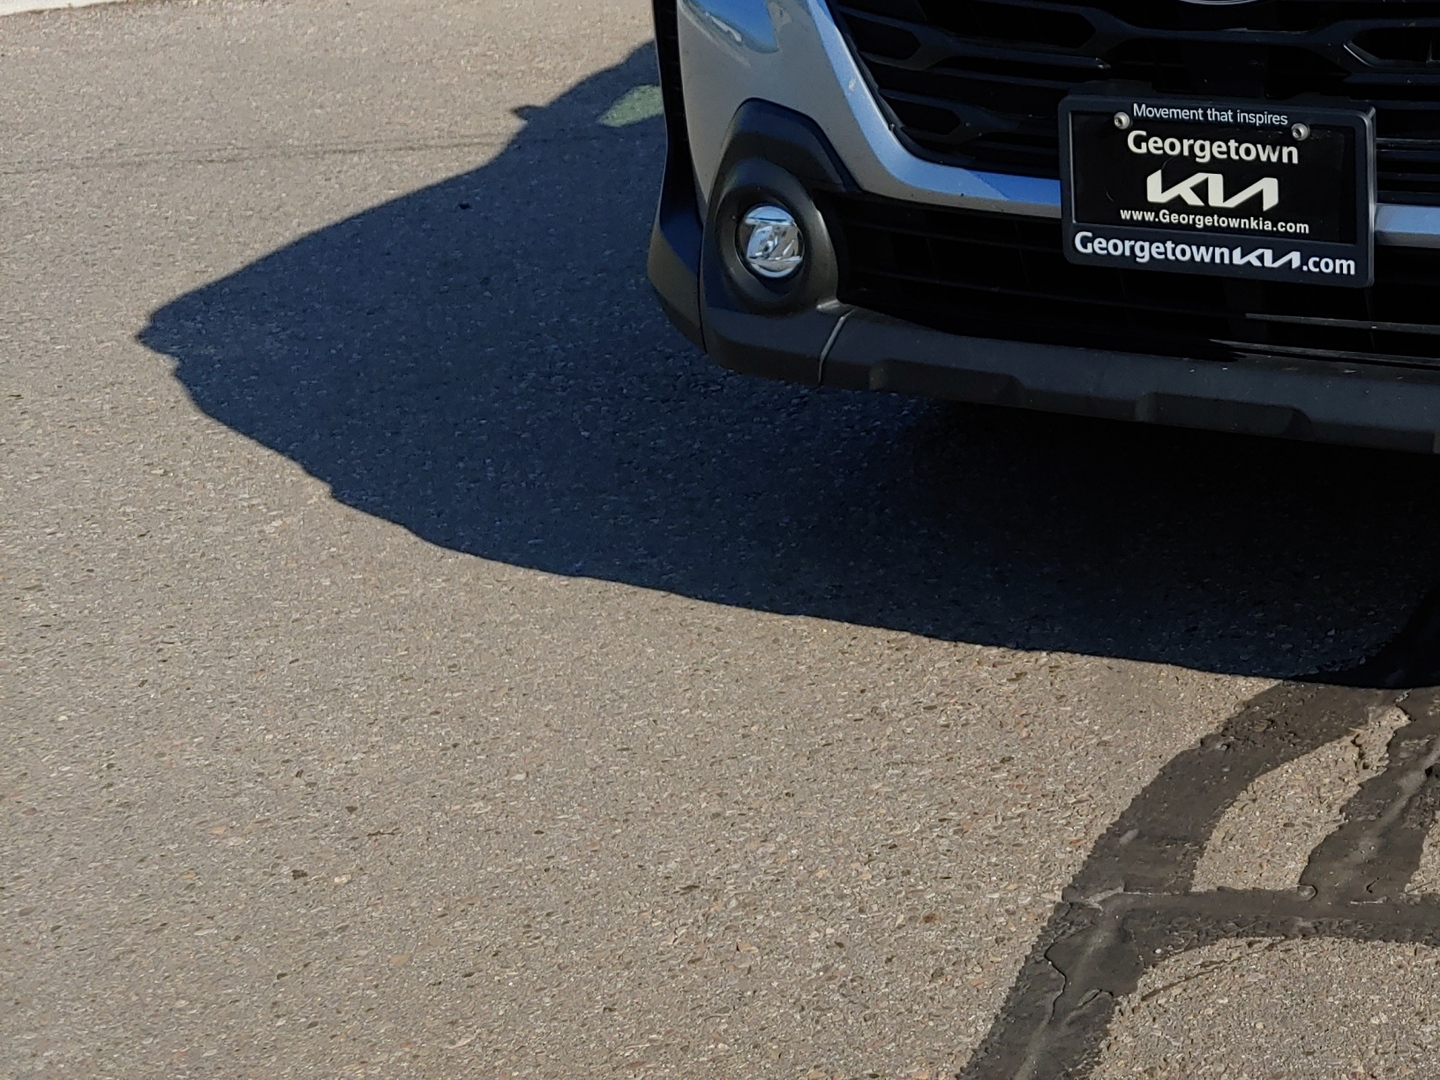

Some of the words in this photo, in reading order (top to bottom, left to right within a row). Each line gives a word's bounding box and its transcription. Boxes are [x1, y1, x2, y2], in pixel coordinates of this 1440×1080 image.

[1133, 103, 1204, 120] Movement
[1206, 107, 1234, 123] that
[1236, 109, 1288, 126] inspires
[1127, 130, 1299, 164] Georgetown
[1146, 170, 1279, 212] KIA
[1120, 208, 1310, 234] www.Georgetownkia.com
